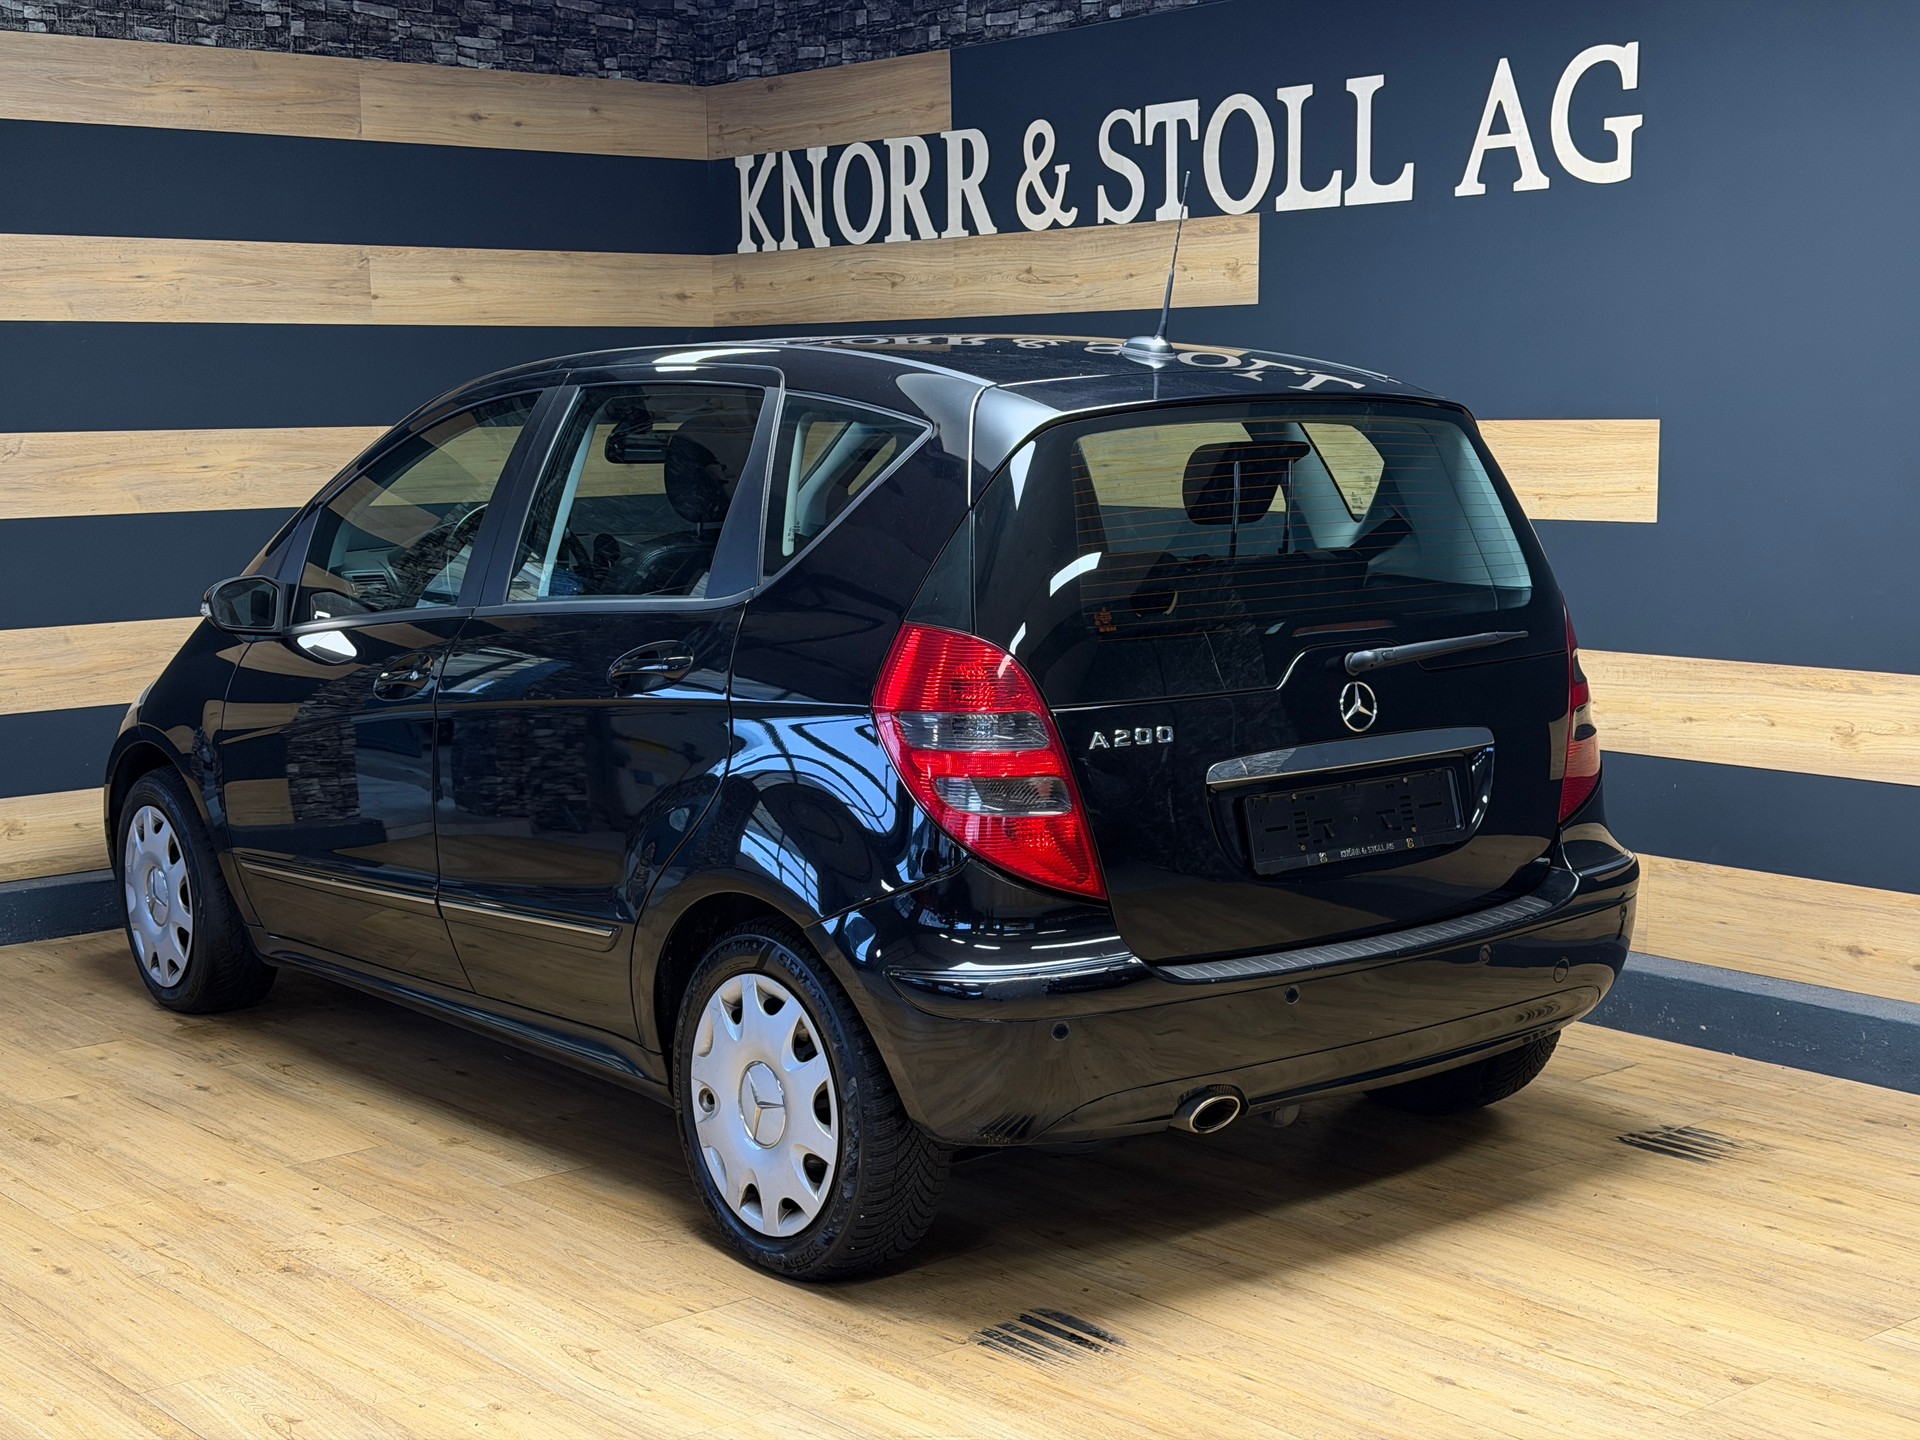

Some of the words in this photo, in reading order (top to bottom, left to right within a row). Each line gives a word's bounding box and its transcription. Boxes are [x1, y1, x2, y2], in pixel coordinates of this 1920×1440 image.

[736, 128, 998, 254] KNORR
[1016, 119, 1078, 231] &
[1098, 74, 1415, 225] STOLL
[1454, 41, 1643, 197] AG
[1088, 726, 1174, 750] A200
